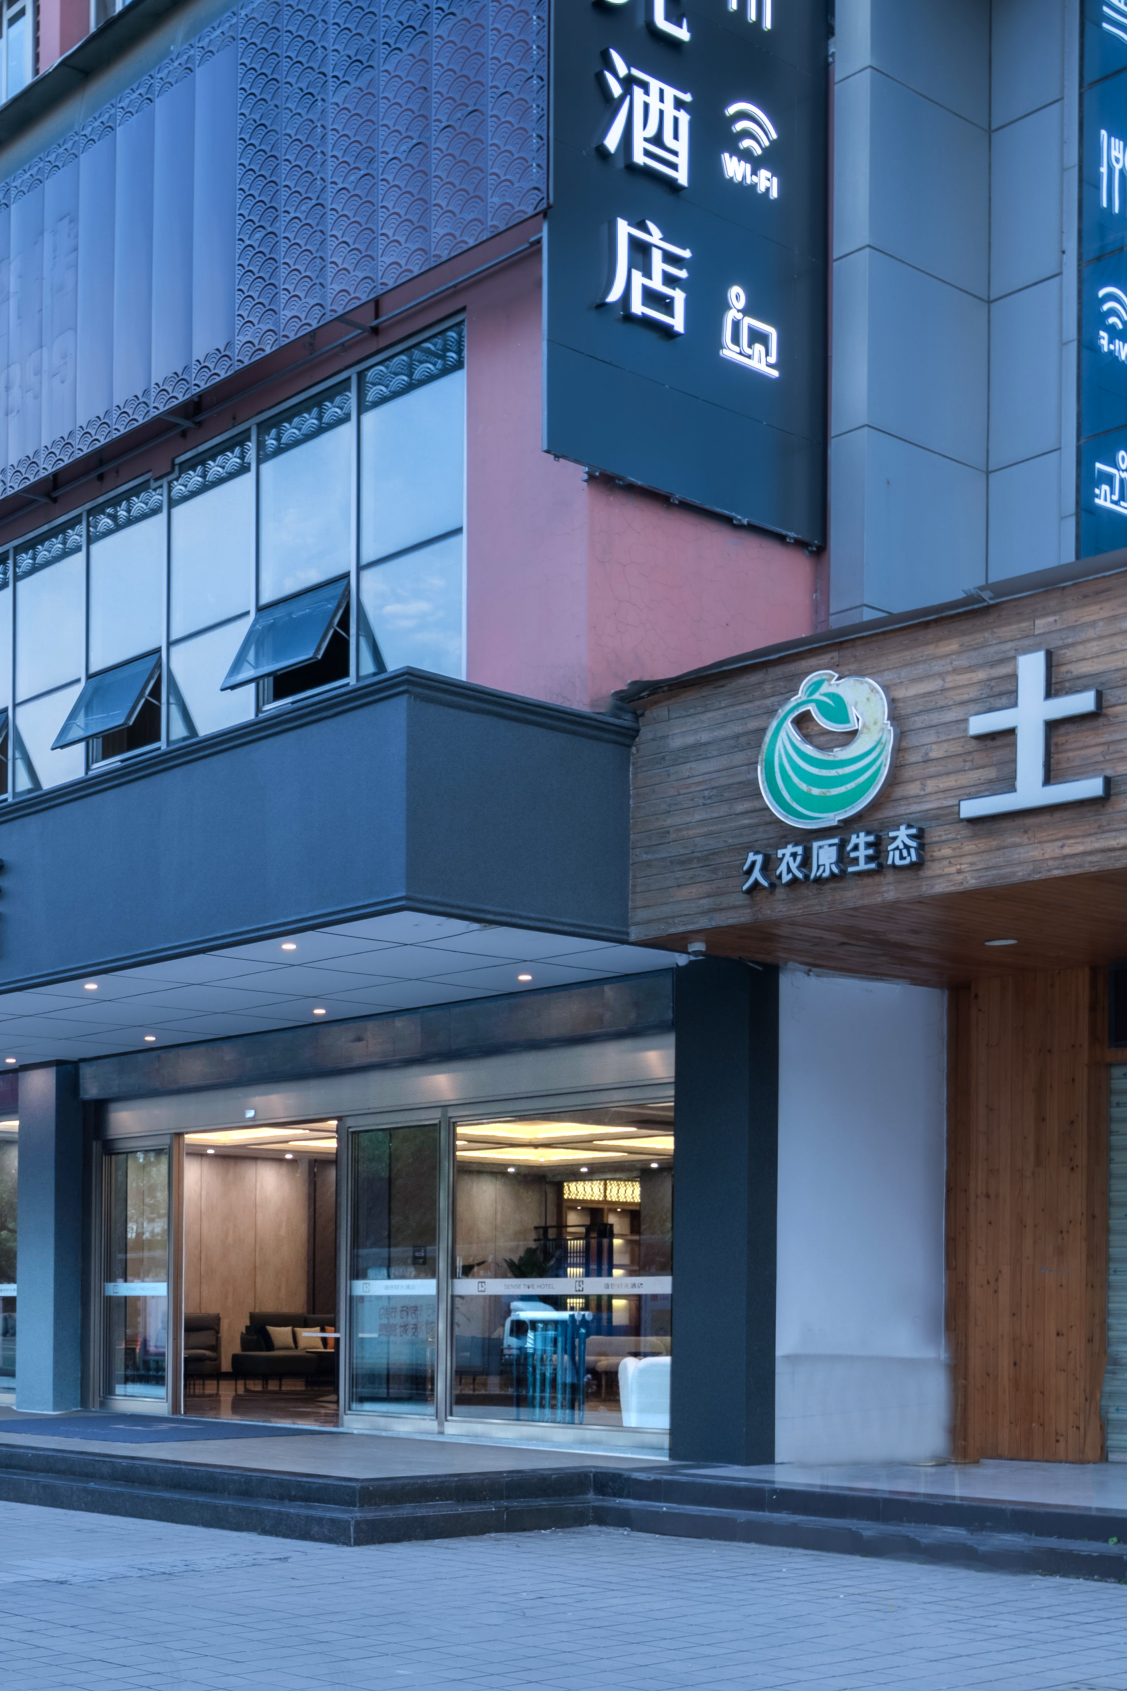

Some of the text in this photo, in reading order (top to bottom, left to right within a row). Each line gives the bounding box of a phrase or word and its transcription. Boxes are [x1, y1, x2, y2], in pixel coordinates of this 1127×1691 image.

[721, 152, 778, 200] WI-FI
[959, 649, 1109, 819] 土
[742, 824, 920, 893] 久农原生态
